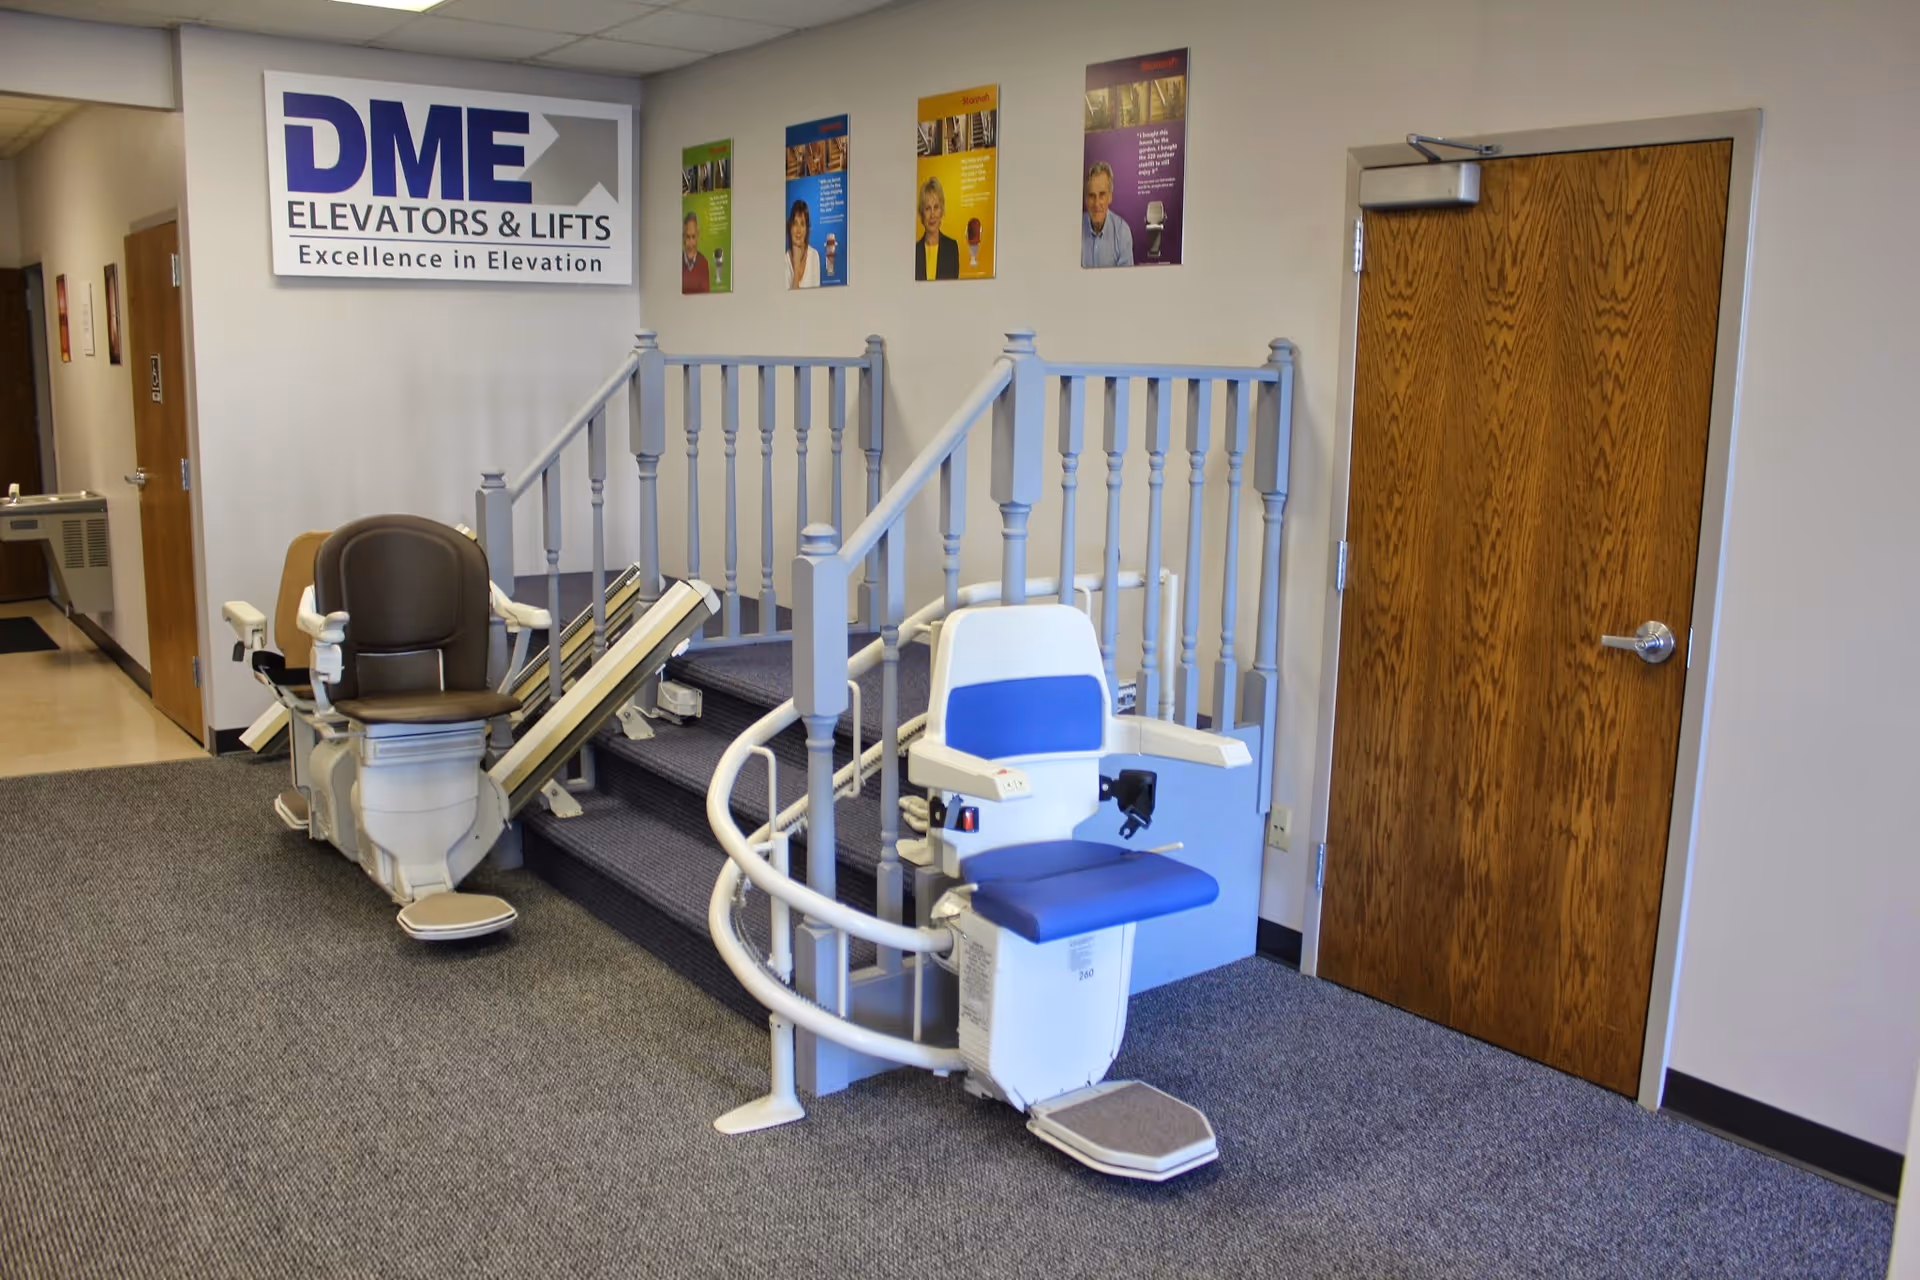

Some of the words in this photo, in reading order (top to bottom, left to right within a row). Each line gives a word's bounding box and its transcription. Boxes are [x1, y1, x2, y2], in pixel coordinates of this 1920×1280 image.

[282, 91, 532, 204] DME
[1160, 143, 1178, 151] bought
[287, 200, 489, 237] ELEVATORS
[498, 210, 521, 238] &
[531, 212, 611, 241] LIFTS
[299, 244, 443, 268] Excellence
[454, 250, 476, 269] in
[488, 250, 602, 272] Elevation
